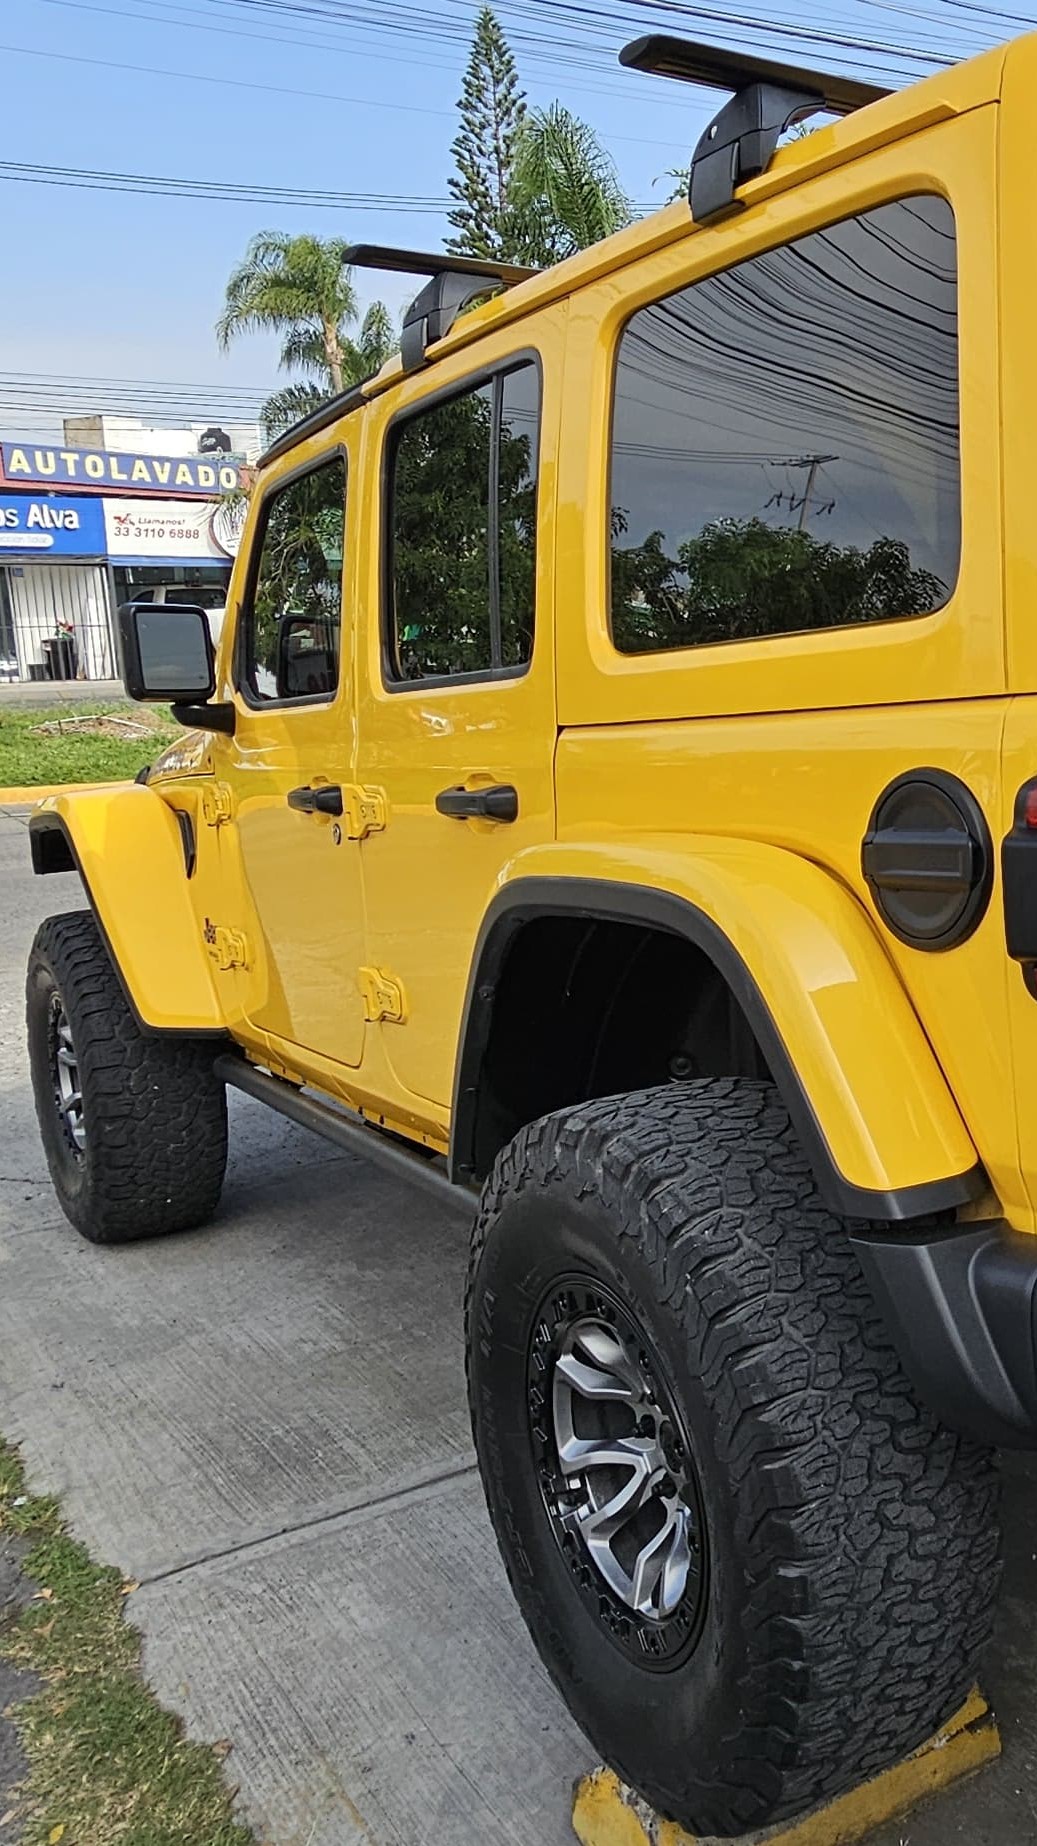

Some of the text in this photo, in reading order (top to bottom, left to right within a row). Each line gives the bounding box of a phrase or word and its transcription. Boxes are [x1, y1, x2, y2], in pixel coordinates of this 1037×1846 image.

[9, 449, 237, 489] AUTOLAVADO
[27, 504, 79, 530] Alva
[114, 527, 200, 540] 33 3110 6888
